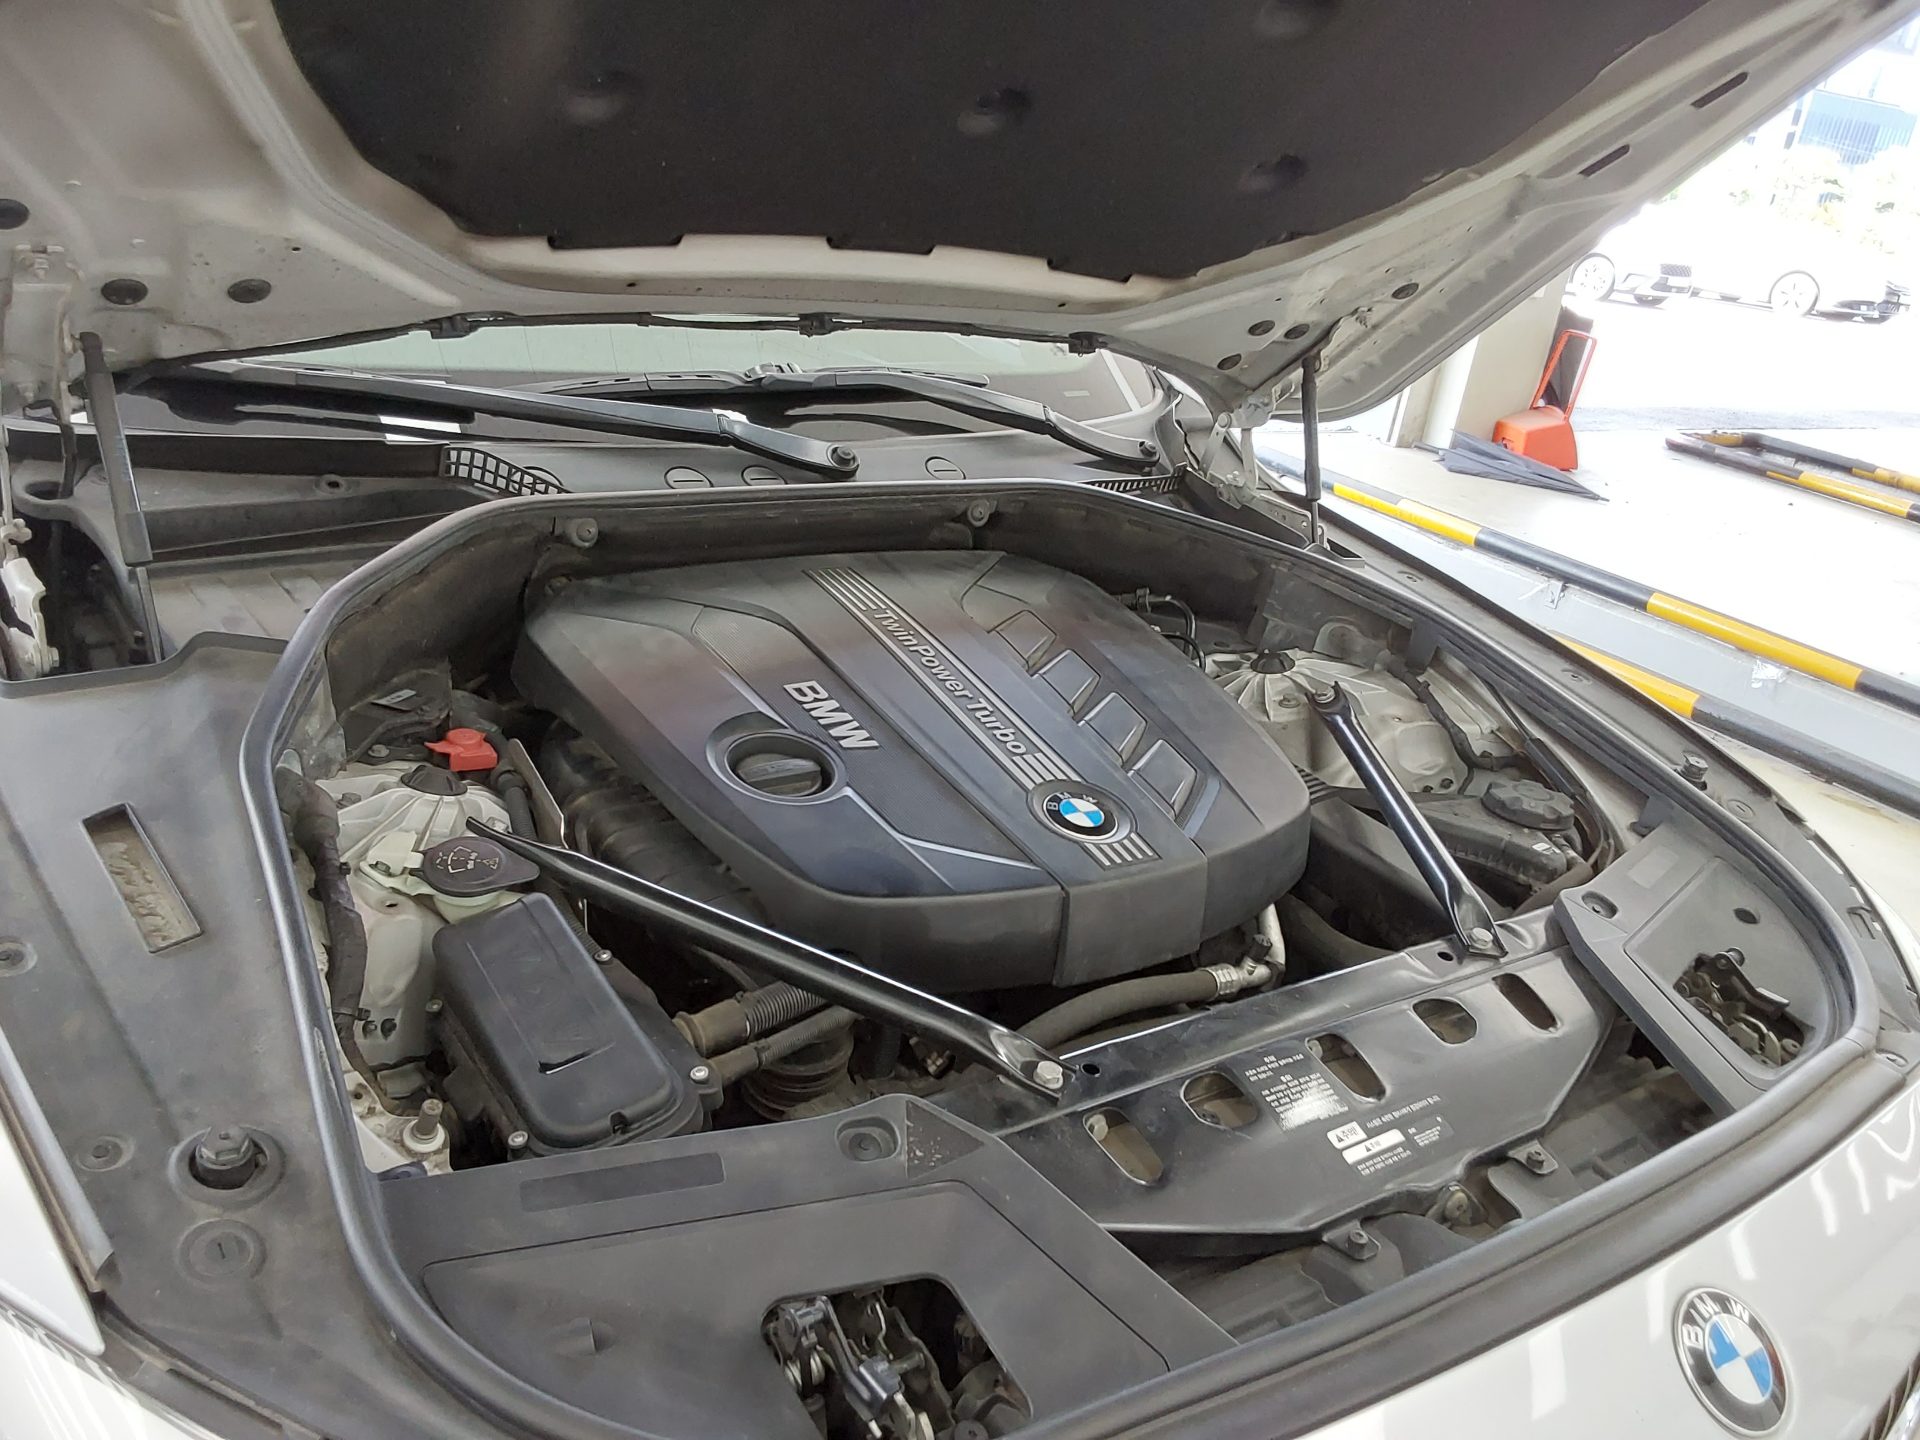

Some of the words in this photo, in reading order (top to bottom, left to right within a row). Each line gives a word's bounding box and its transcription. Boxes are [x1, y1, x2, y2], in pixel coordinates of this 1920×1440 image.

[873, 608, 973, 699] TwinPower
[965, 698, 1027, 755] Turbo
[783, 680, 879, 749] BMW
[1047, 792, 1099, 811] BMW
[1682, 1293, 1749, 1349] BMW
